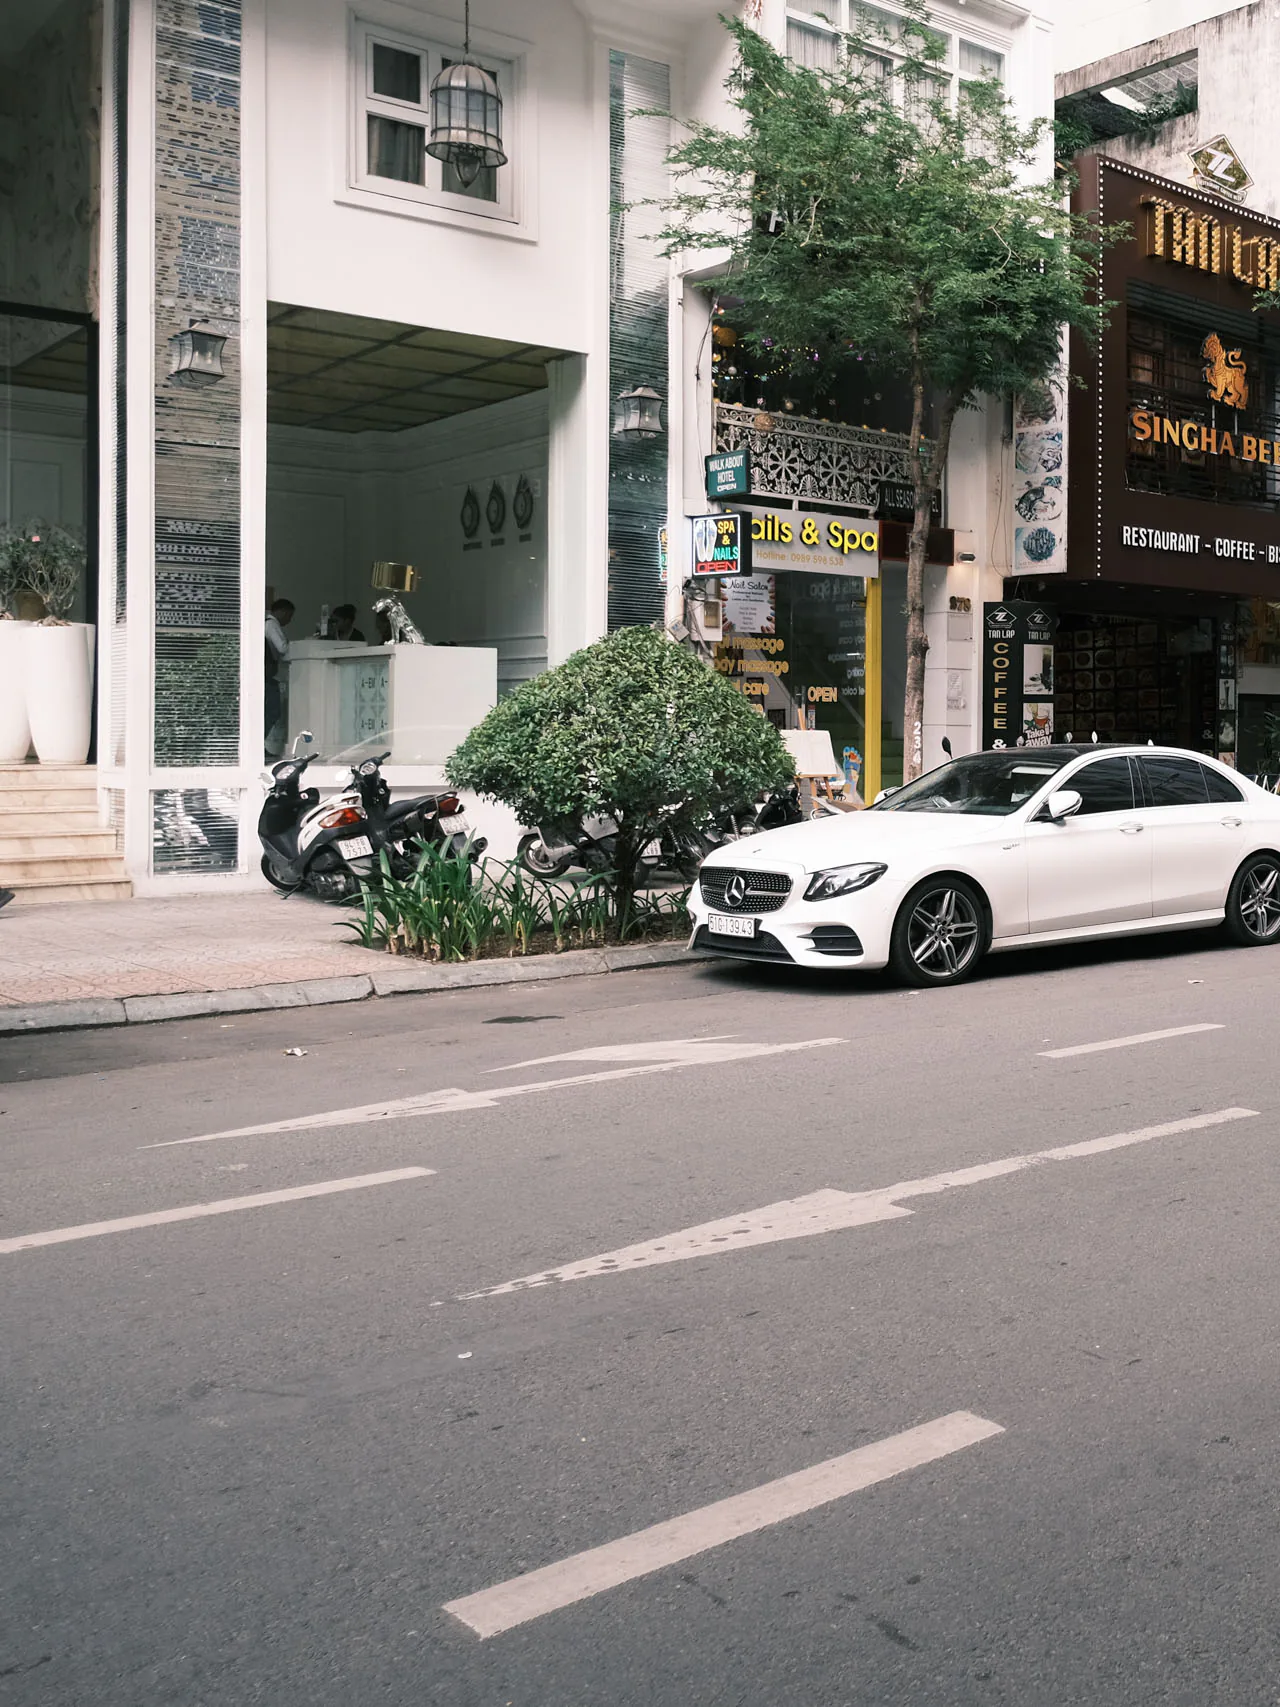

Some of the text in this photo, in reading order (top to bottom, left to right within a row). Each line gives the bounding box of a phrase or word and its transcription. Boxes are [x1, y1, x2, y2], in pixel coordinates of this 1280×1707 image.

[1132, 412, 1235, 457] SINGHA
[709, 455, 743, 472] WALK ABOUT
[717, 470, 735, 483] HOTEL
[717, 483, 736, 492] OPEN
[885, 487, 895, 507] ALL
[896, 488, 914, 510] SEASO
[718, 520, 735, 534] SPA
[750, 513, 878, 554] ails & Spa
[722, 535, 730, 545] &
[1122, 525, 1200, 553] RESTAURANT
[1215, 537, 1255, 561] COFFEE
[714, 546, 739, 560] NAILS
[790, 552, 810, 563] 0989
[697, 561, 736, 573] OPEN
[728, 579, 745, 589] Nail
[988, 630, 1015, 639] TAN LAP
[733, 637, 785, 655] massage
[737, 660, 789, 677] massage
[743, 682, 769, 695] care
[992, 642, 1010, 729] COFFEE
[807, 686, 838, 702] OPEN
[1025, 729, 1045, 739] Take
[992, 738, 1007, 750] &
[709, 915, 753, 935] 51G-139.43
